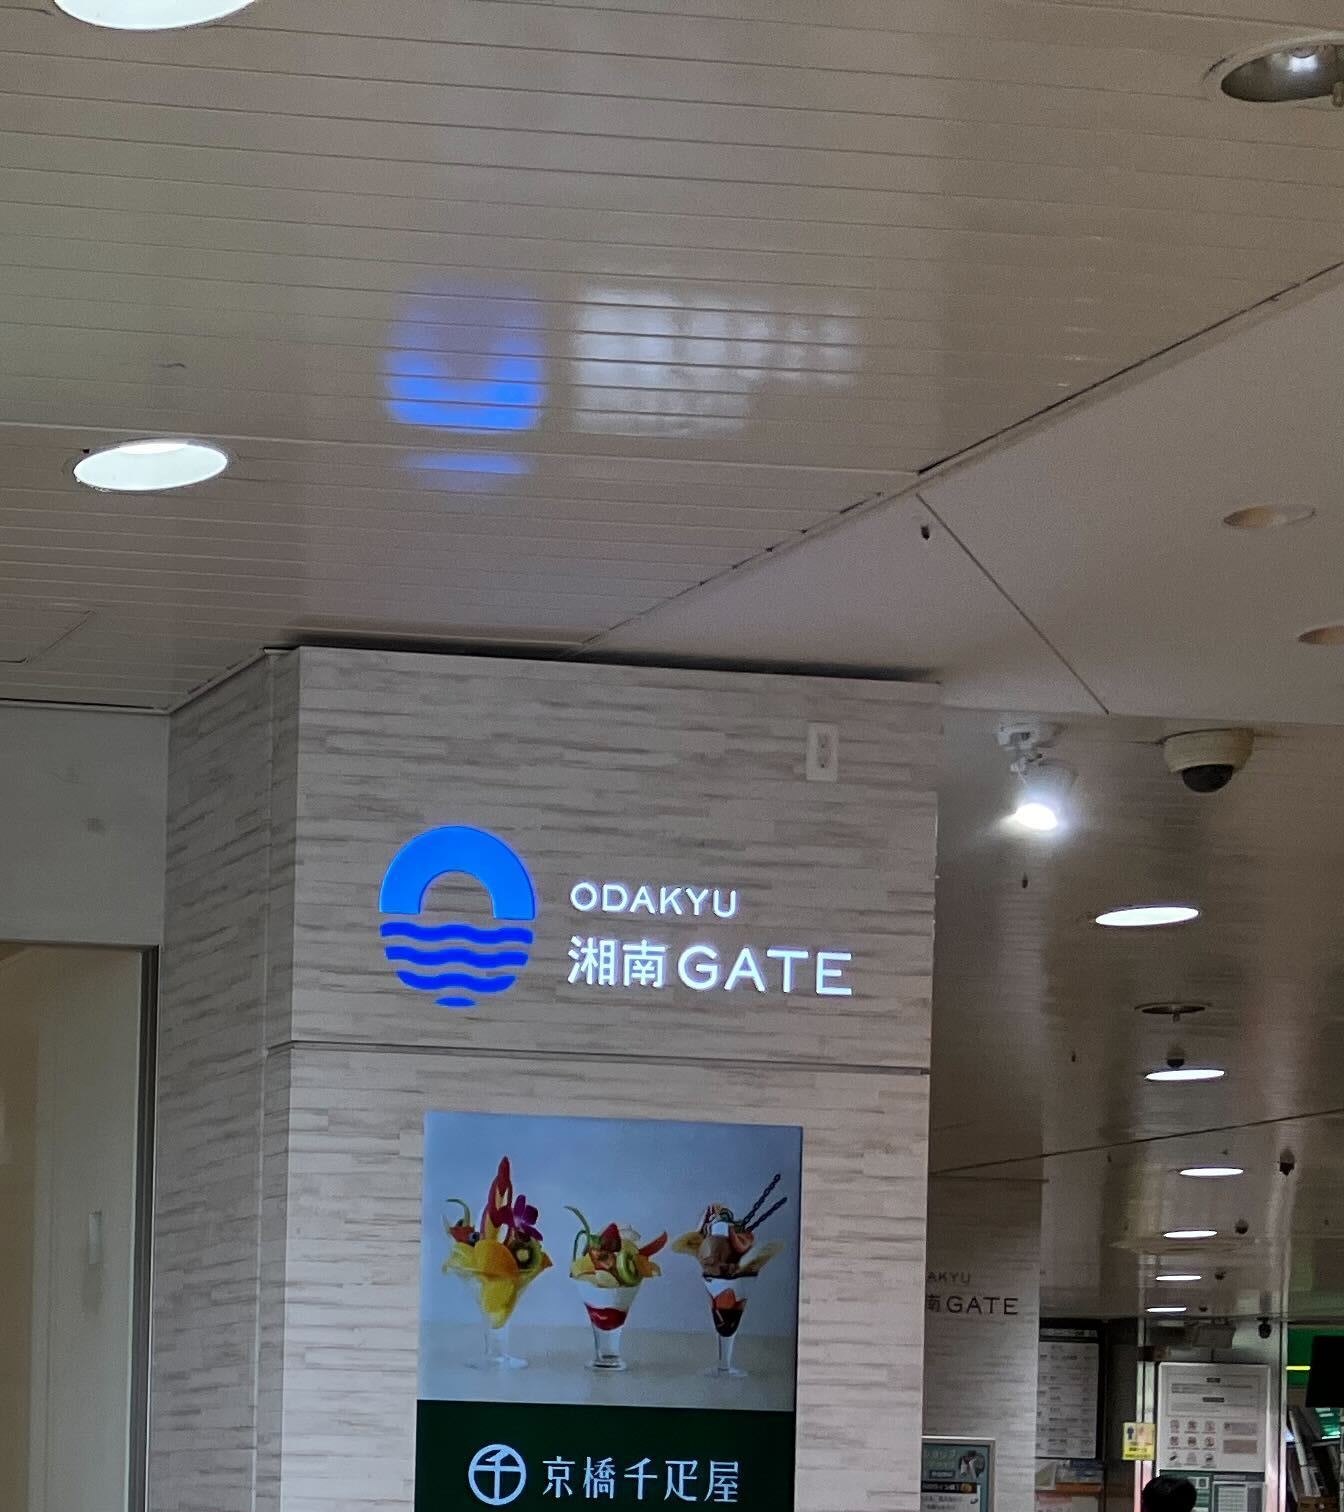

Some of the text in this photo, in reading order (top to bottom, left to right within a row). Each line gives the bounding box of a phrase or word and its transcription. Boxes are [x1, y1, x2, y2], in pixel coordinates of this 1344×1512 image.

[570, 881, 738, 918] ODAKYU
[926, 1271, 971, 1284] AKYU
[926, 1294, 1019, 1315] 南GATE
[541, 1455, 741, 1504] 京橋千疋屋
